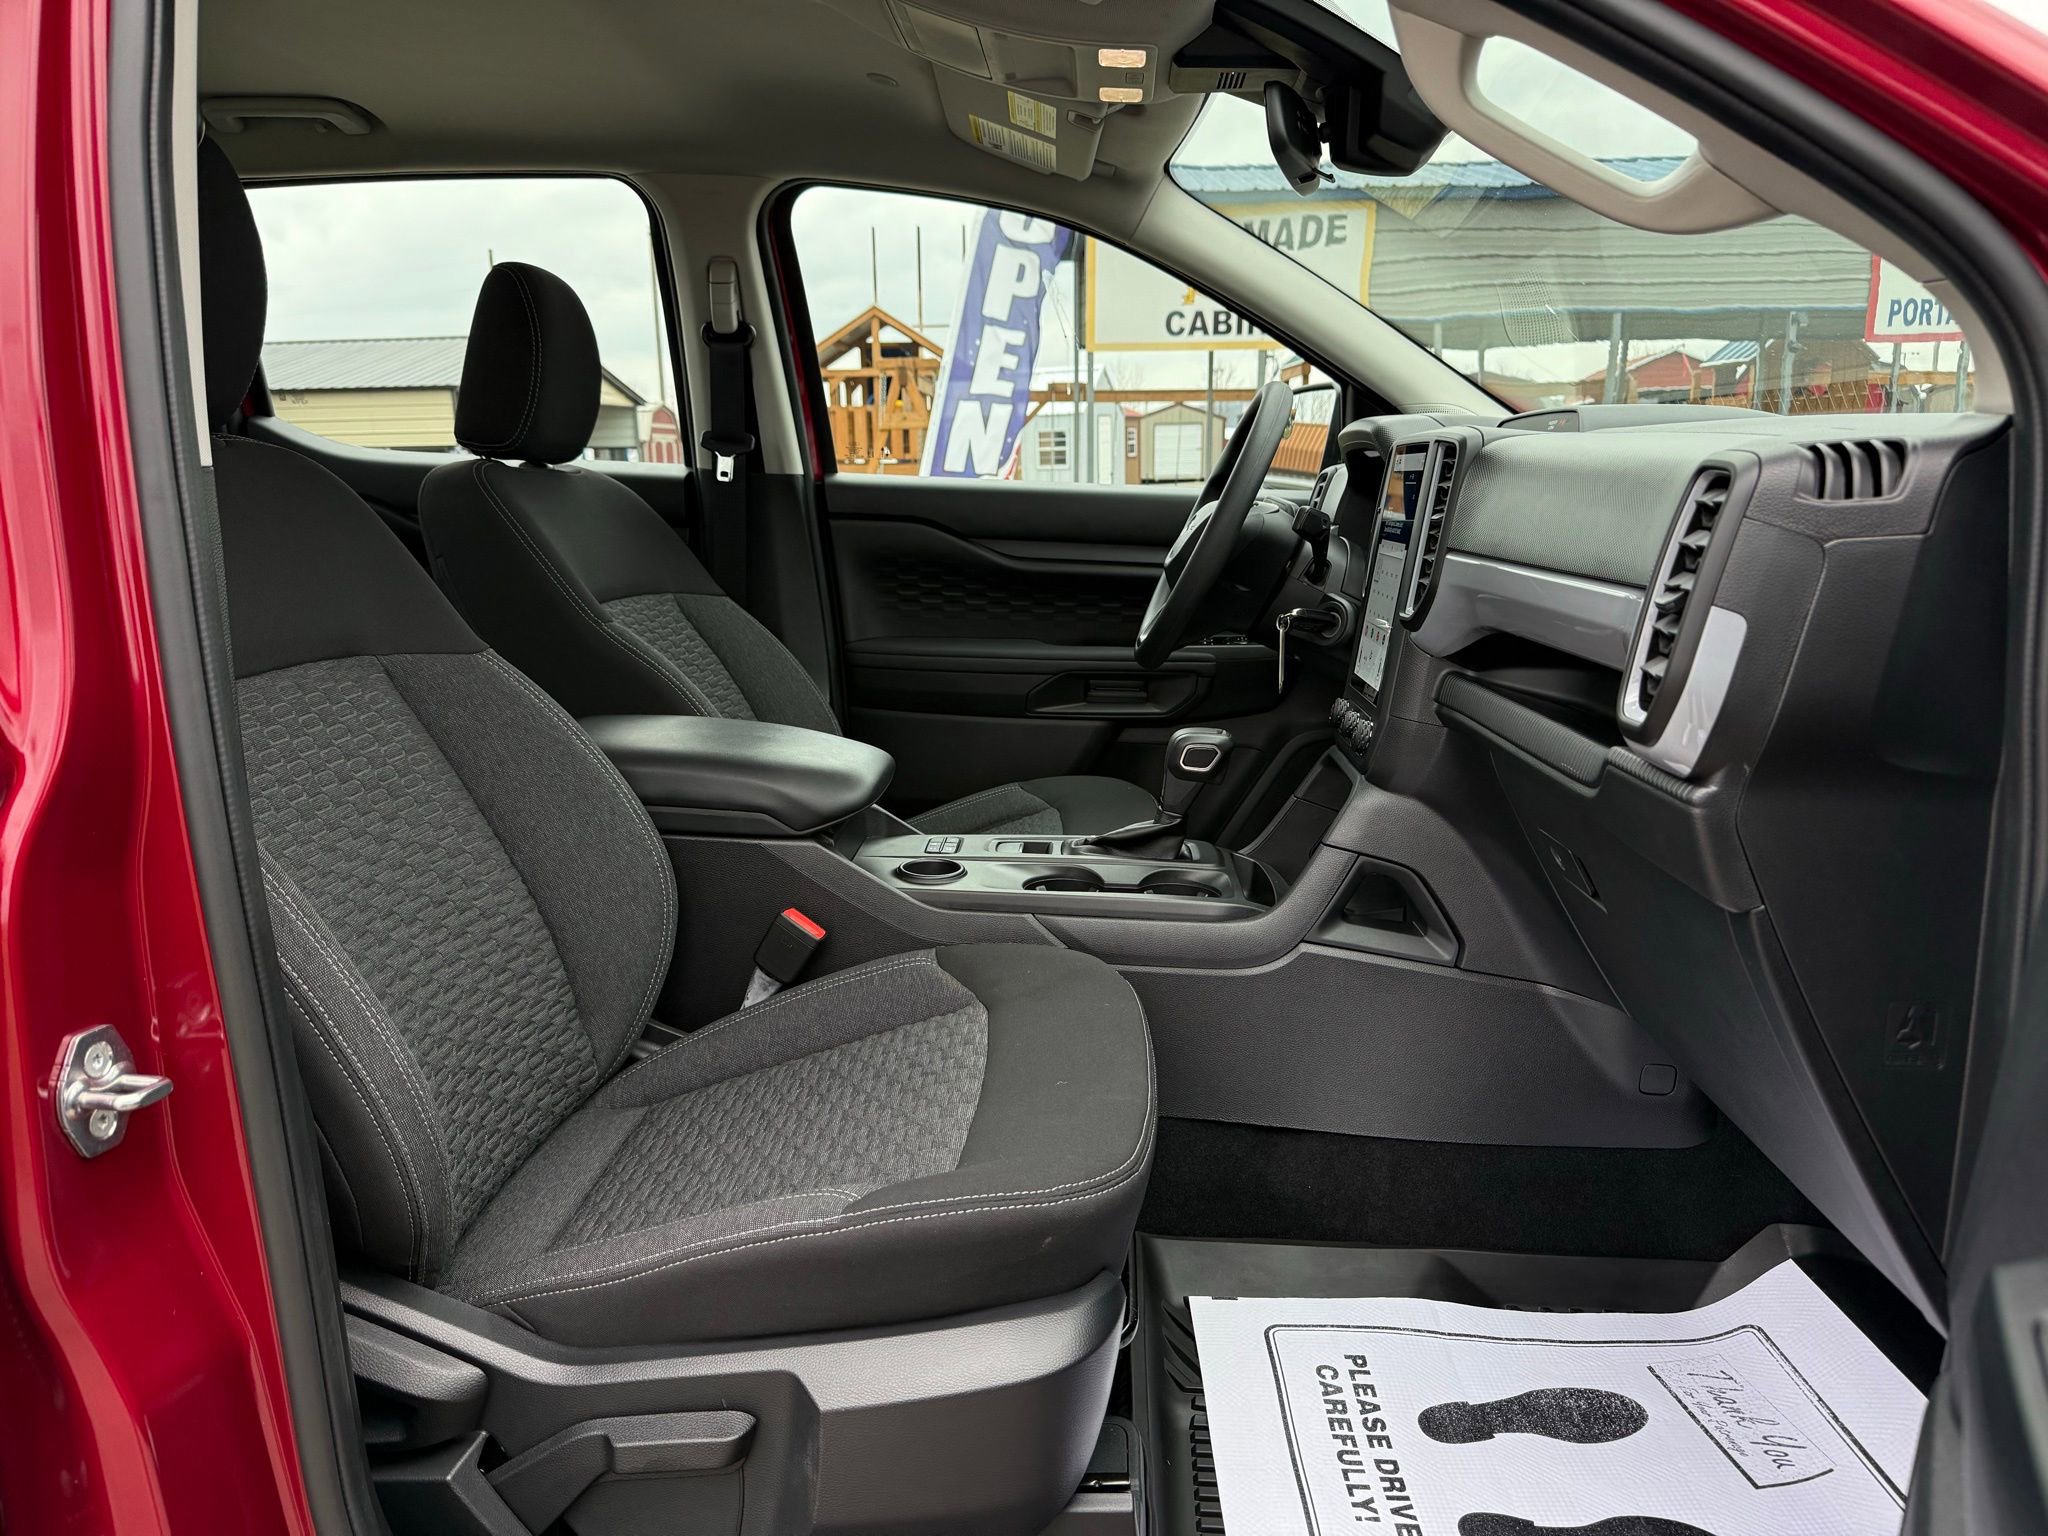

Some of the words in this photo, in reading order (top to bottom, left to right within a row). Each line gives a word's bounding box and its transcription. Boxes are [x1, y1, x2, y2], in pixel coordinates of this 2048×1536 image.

[1315, 1364, 1382, 1523] CAREFULLY!
[1343, 1354, 1393, 1449] PLEASE
[1373, 1458, 1424, 1536] DRIVE
[1686, 1369, 1780, 1430] Thank
[1750, 1434, 1807, 1469] You
